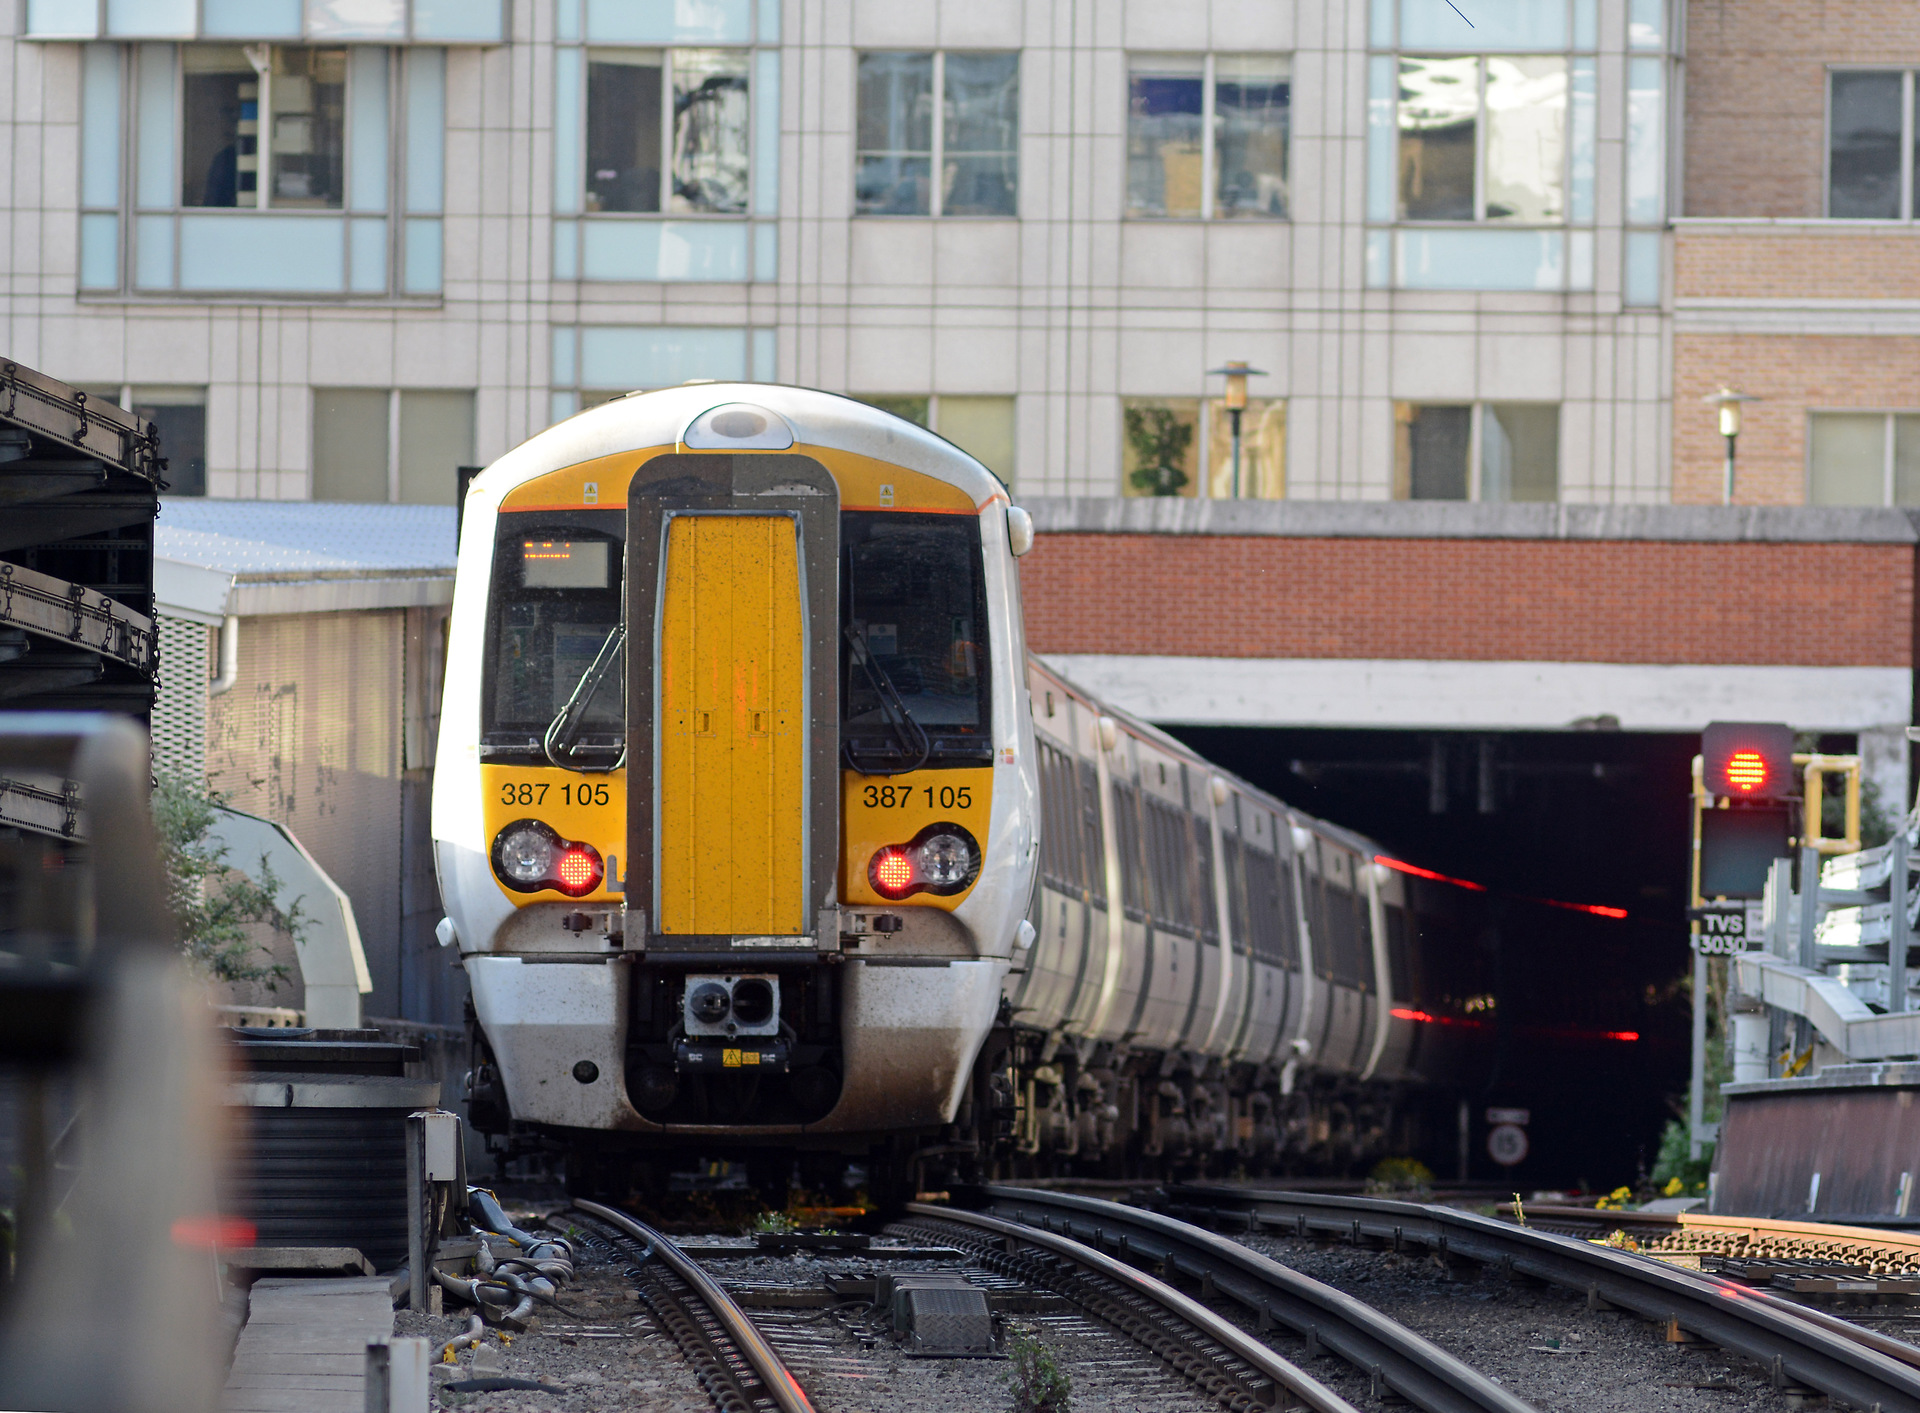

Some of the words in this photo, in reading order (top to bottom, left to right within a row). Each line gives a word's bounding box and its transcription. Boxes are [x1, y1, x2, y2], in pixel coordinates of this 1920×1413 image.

[500, 783, 549, 806] 387
[560, 783, 610, 806] 105
[862, 785, 912, 808] 387
[923, 785, 972, 809] 105
[1703, 913, 1744, 934] TVS
[1699, 934, 1748, 955] 3030
